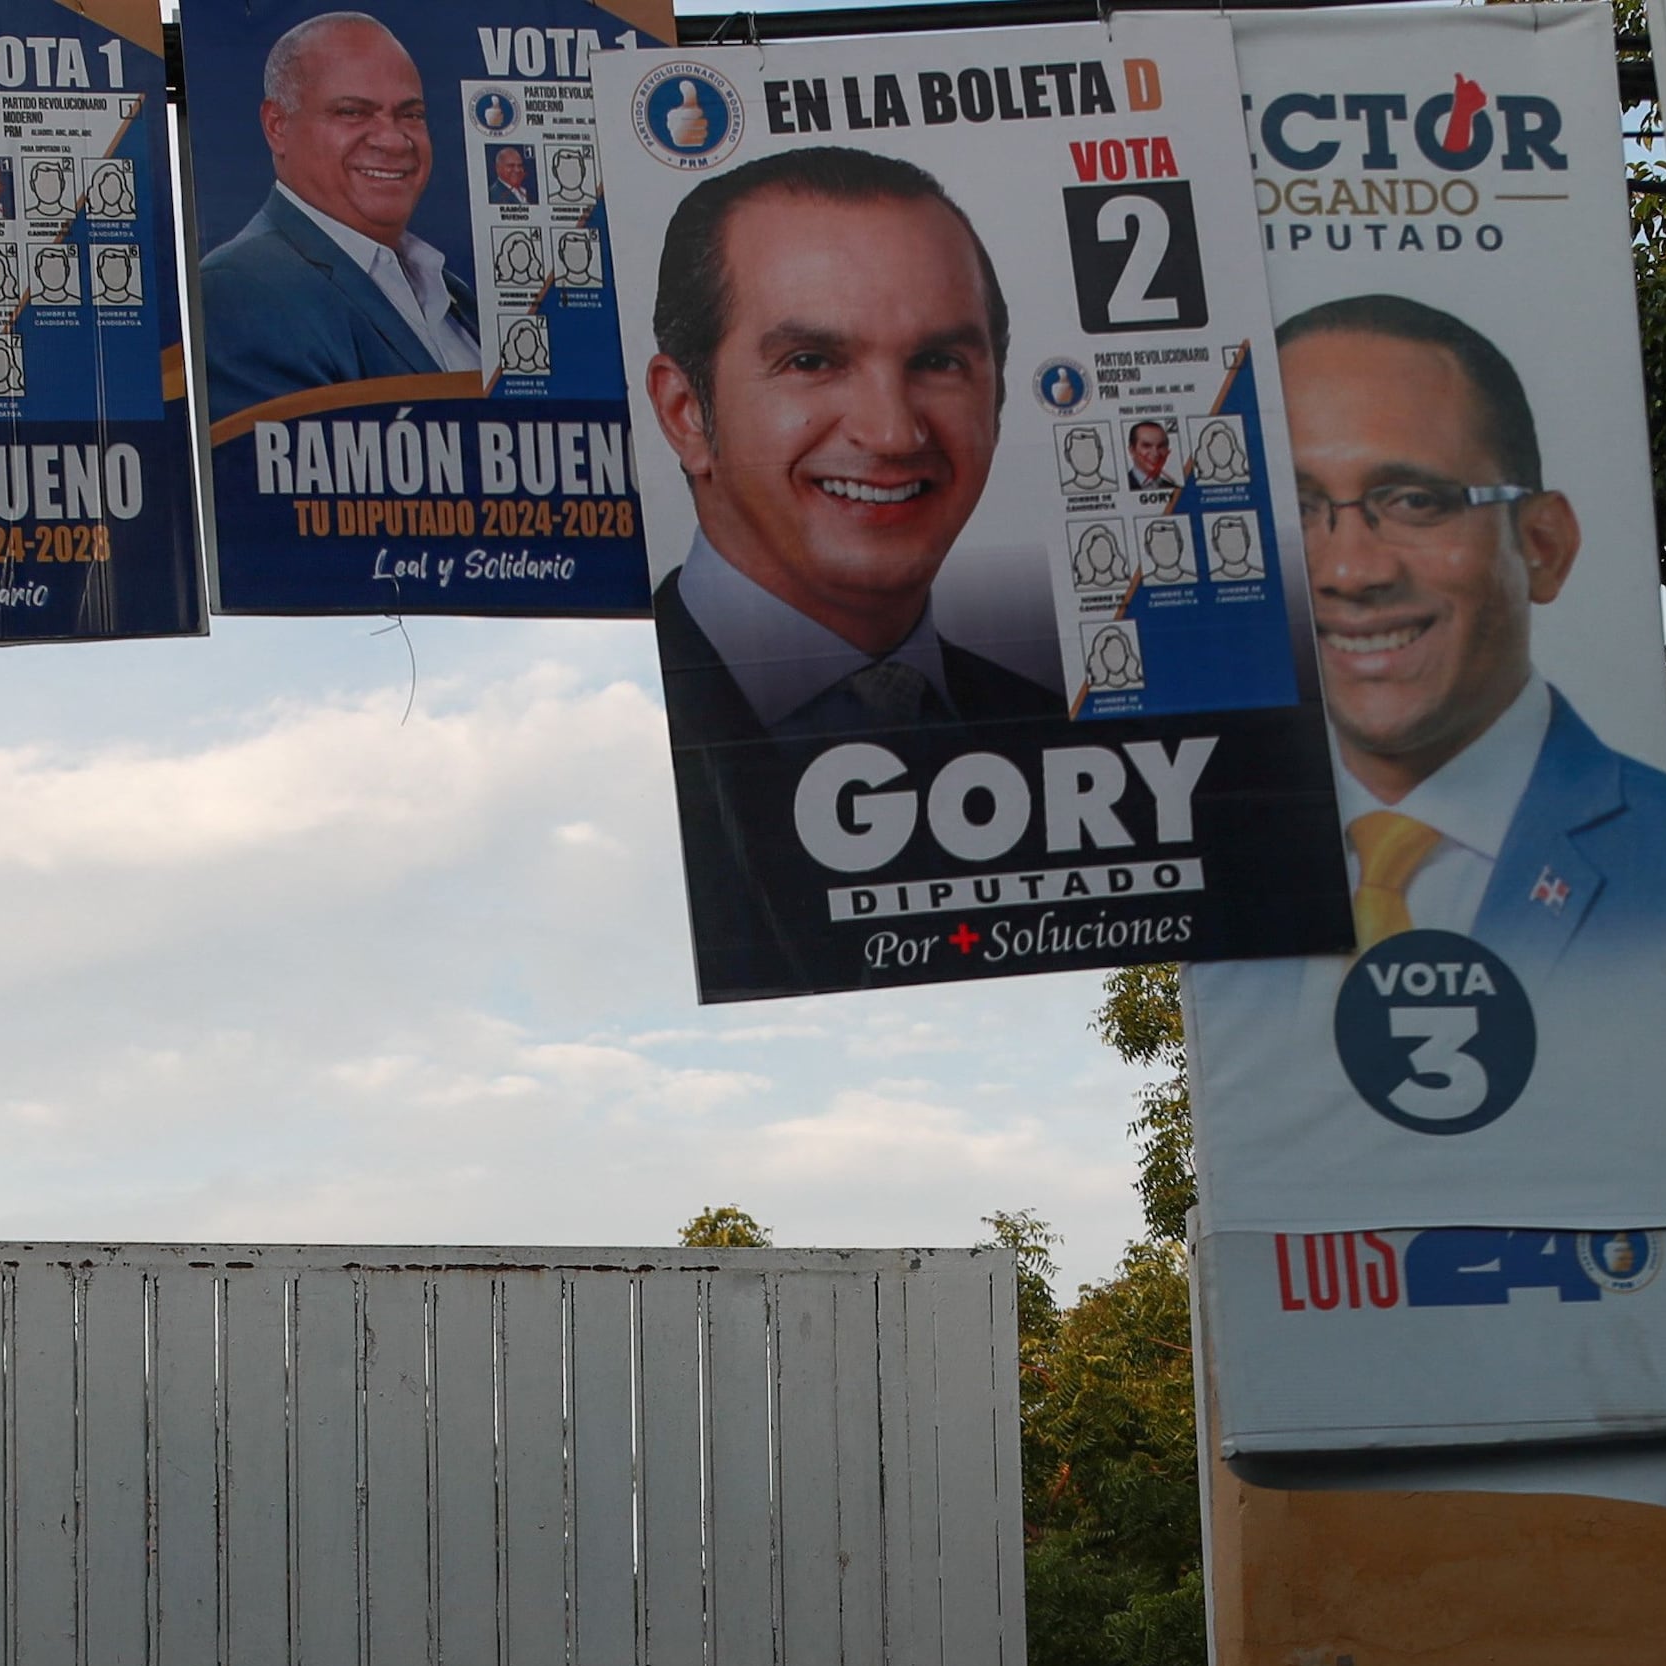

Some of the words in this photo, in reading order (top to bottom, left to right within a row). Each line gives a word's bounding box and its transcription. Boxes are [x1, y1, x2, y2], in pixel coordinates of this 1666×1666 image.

[98, 39, 124, 88] 1
[477, 27, 601, 76] VOTA
[764, 80, 831, 134] EN
[845, 74, 910, 130] LA
[917, 60, 1116, 125] BOLETA
[1122, 58, 1163, 112] D
[1069, 136, 1179, 183] VOTA
[1255, 178, 1479, 216] OGANDO
[1095, 194, 1180, 325] 2
[1265, 224, 1504, 251] IPUTADO
[254, 407, 464, 495] RAMÓN
[294, 501, 330, 536] TU
[338, 501, 474, 537] DIPUTADO
[482, 501, 633, 537] 2024-2028
[372, 548, 426, 580] Leal
[438, 558, 454, 588] y
[465, 549, 576, 580] Solidario
[794, 736, 1220, 873] GORY
[853, 864, 1181, 916] DIPUTADO
[864, 931, 939, 969] Por
[983, 910, 1192, 963] Soluciones
[1366, 963, 1496, 996] VOTA
[1388, 1006, 1488, 1120] 3
[1275, 1231, 1399, 1311] LUIS
